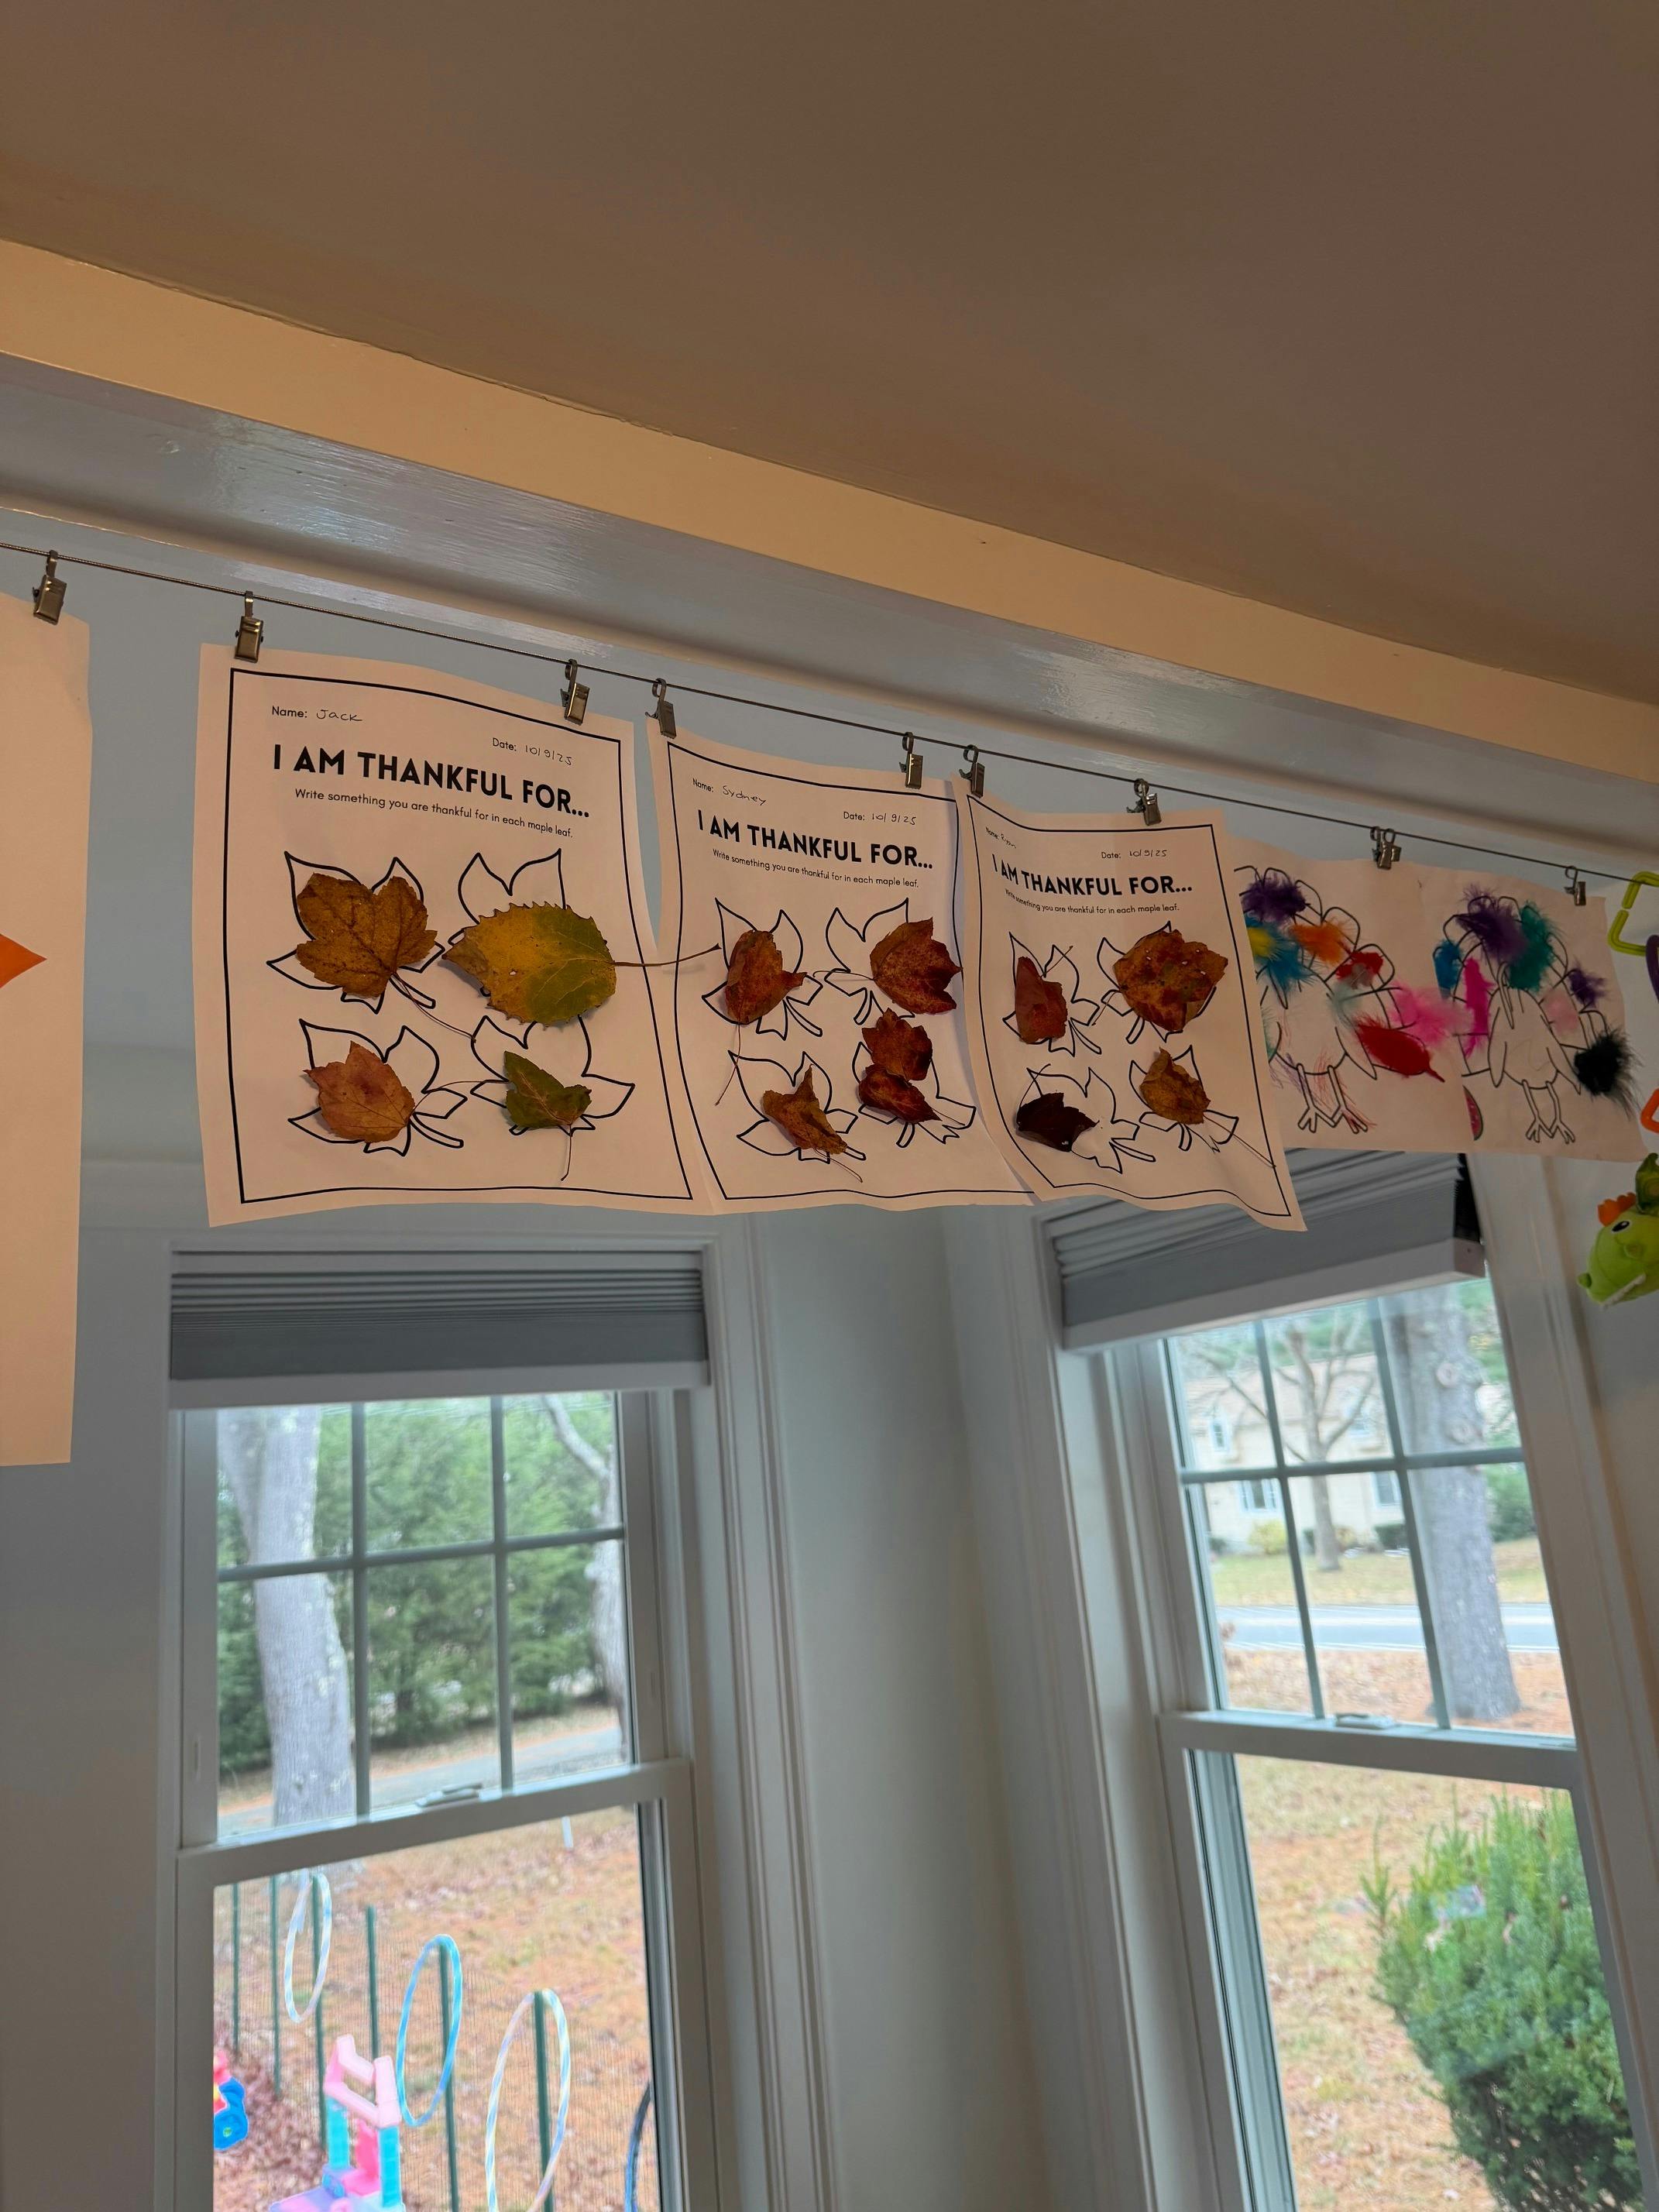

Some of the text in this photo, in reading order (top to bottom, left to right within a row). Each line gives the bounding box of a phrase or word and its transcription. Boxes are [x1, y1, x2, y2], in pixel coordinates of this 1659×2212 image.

[273, 706, 362, 721] Name: Jack
[493, 737, 517, 751] Date:
[274, 744, 589, 817] I AM THANKFUL FOR...
[693, 778, 766, 805] Name: Sydney
[296, 788, 324, 799] Write
[328, 793, 385, 809] something
[390, 800, 407, 810] you
[431, 803, 471, 817] thankful
[475, 809, 489, 820] for
[503, 817, 524, 826] each
[528, 823, 552, 833] maple
[555, 825, 572, 837] leaf.
[843, 812, 864, 820] Date:
[698, 809, 933, 868] I AM THANKFUL FOR...
[713, 849, 729, 860] Write
[732, 857, 770, 871] something
[802, 867, 829, 879] thankful
[832, 872, 842, 881] for
[876, 877, 900, 887] maple
[903, 878, 918, 888] leaf.
[992, 854, 1192, 895] I AM THANKFUL FOR...
[1138, 905, 1160, 913] maple
